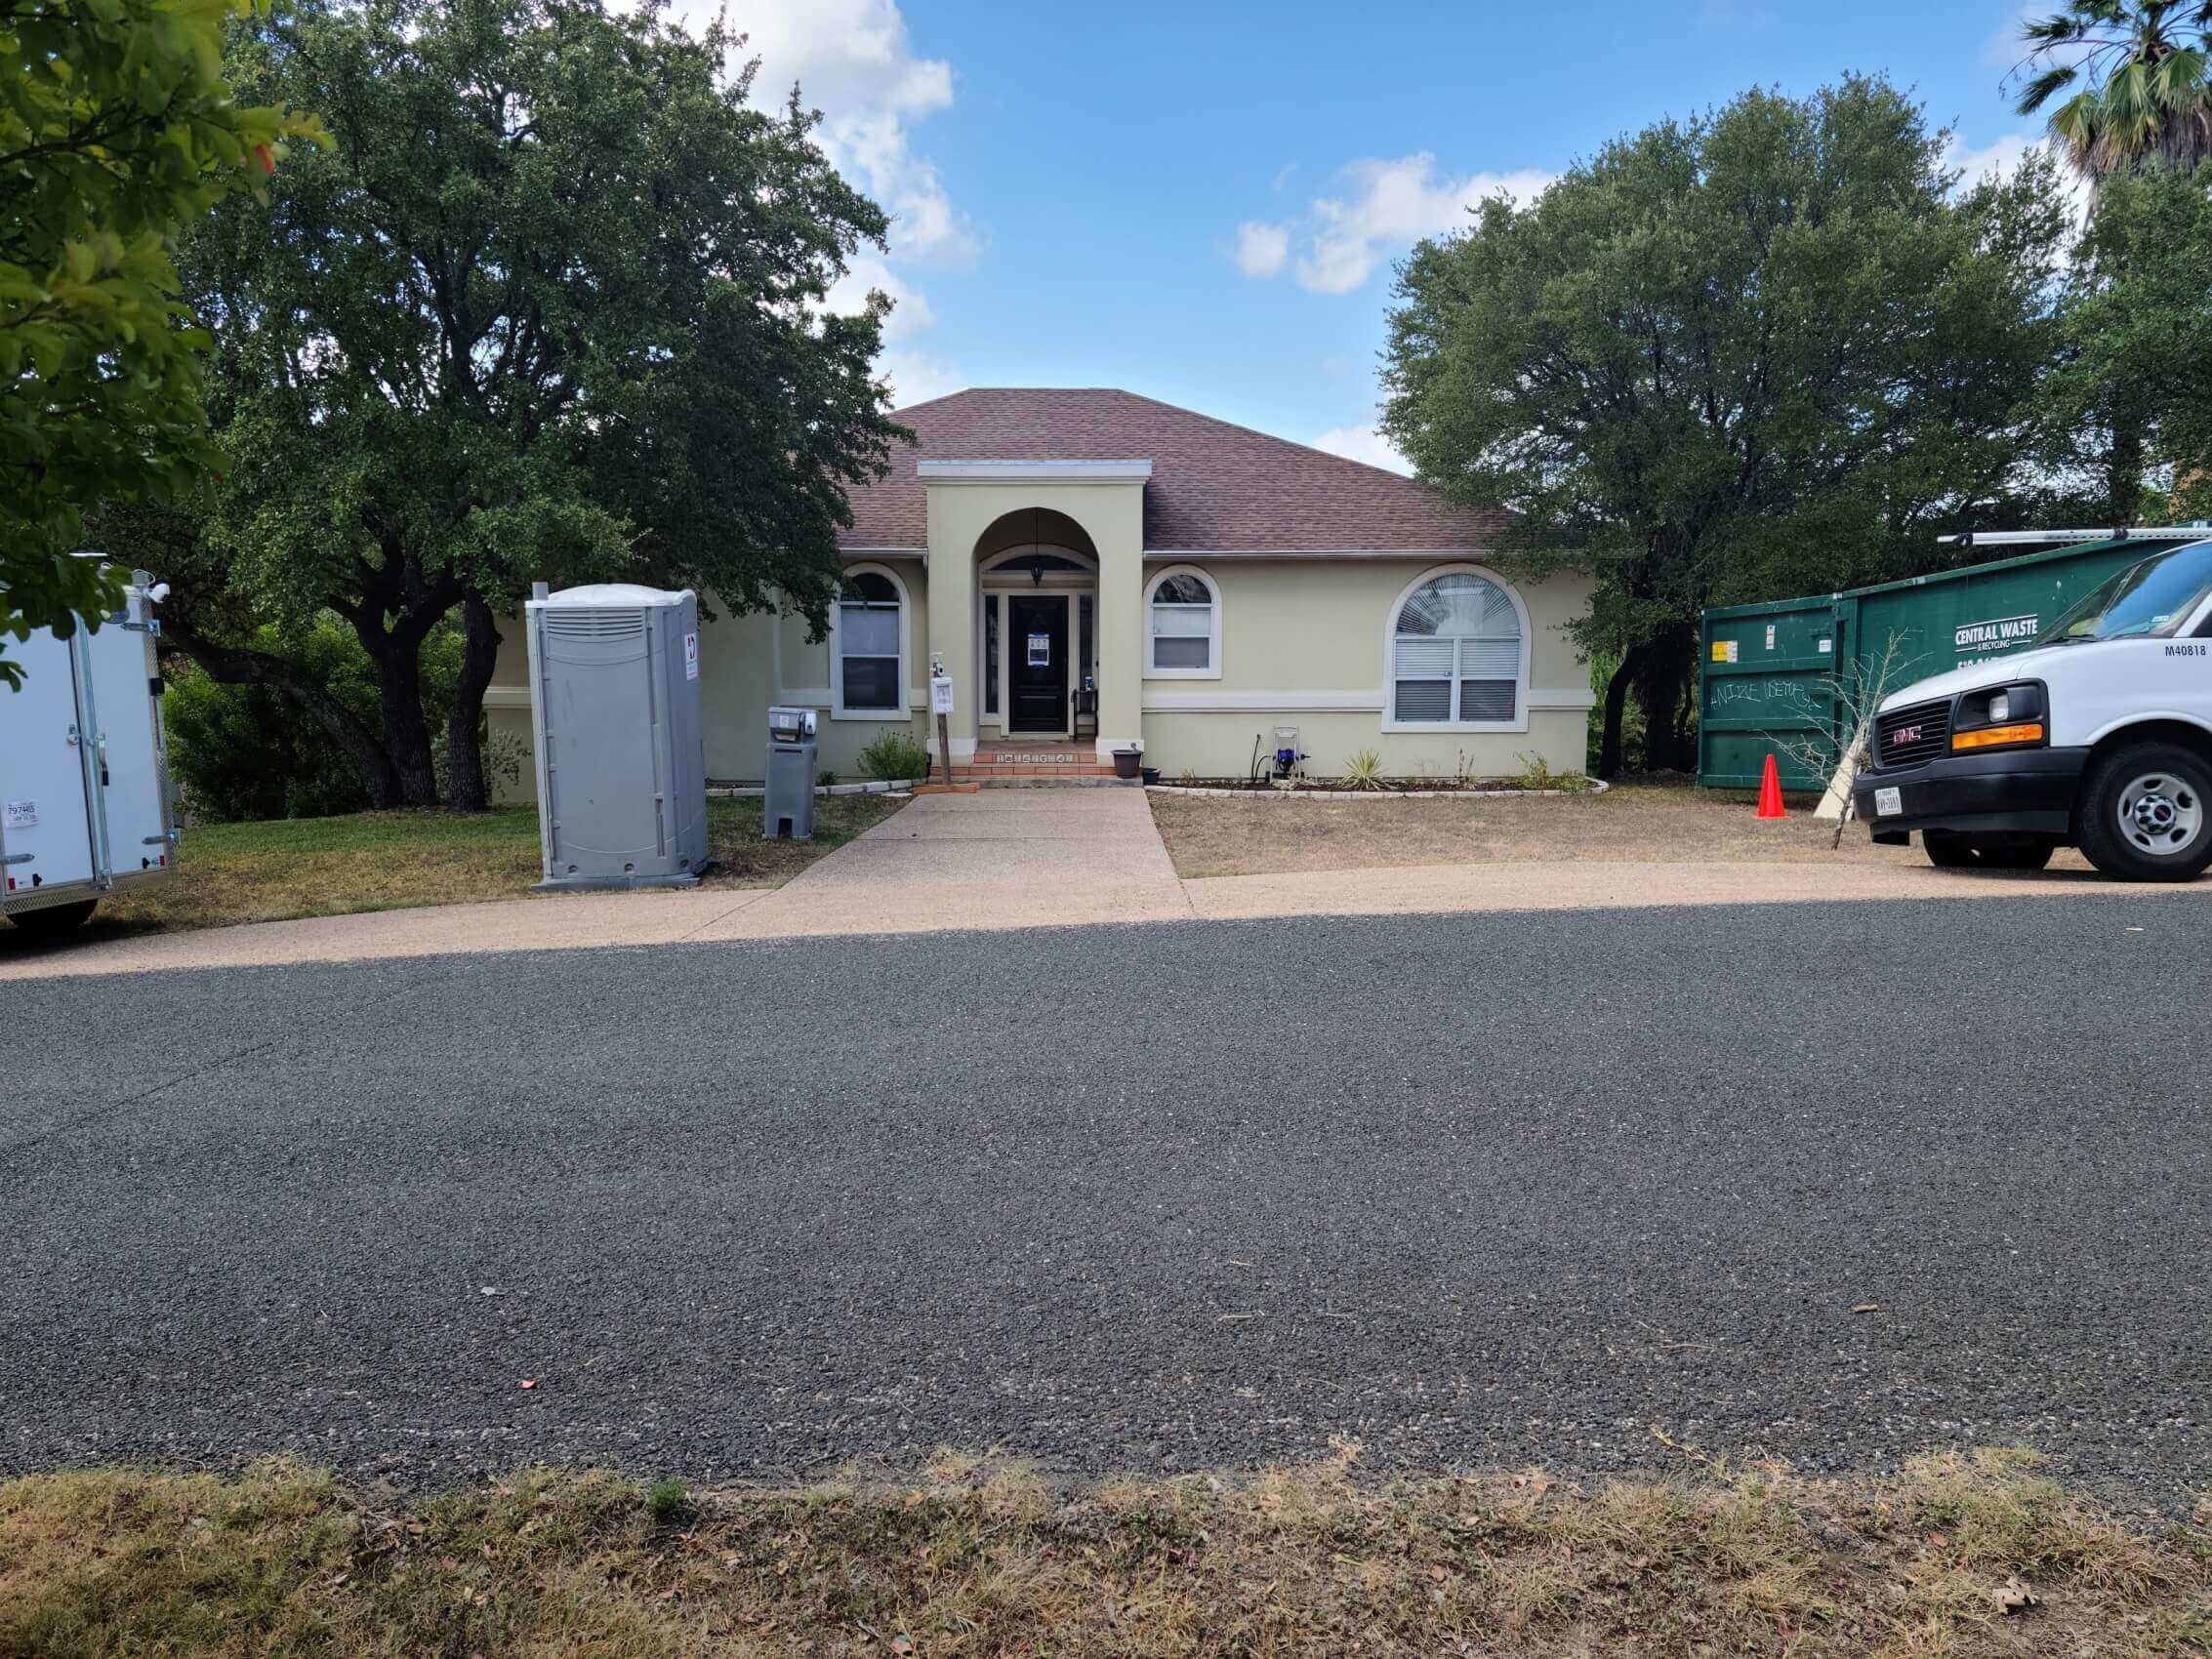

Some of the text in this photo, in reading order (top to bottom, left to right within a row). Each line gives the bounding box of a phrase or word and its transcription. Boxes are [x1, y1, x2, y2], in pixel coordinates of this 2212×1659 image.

[1955, 620, 2038, 645] CENTRAL WASTE
[1983, 639, 2011, 651] RECYCLING
[2165, 645, 2206, 657] M40818
[1894, 725, 1922, 745] GMC
